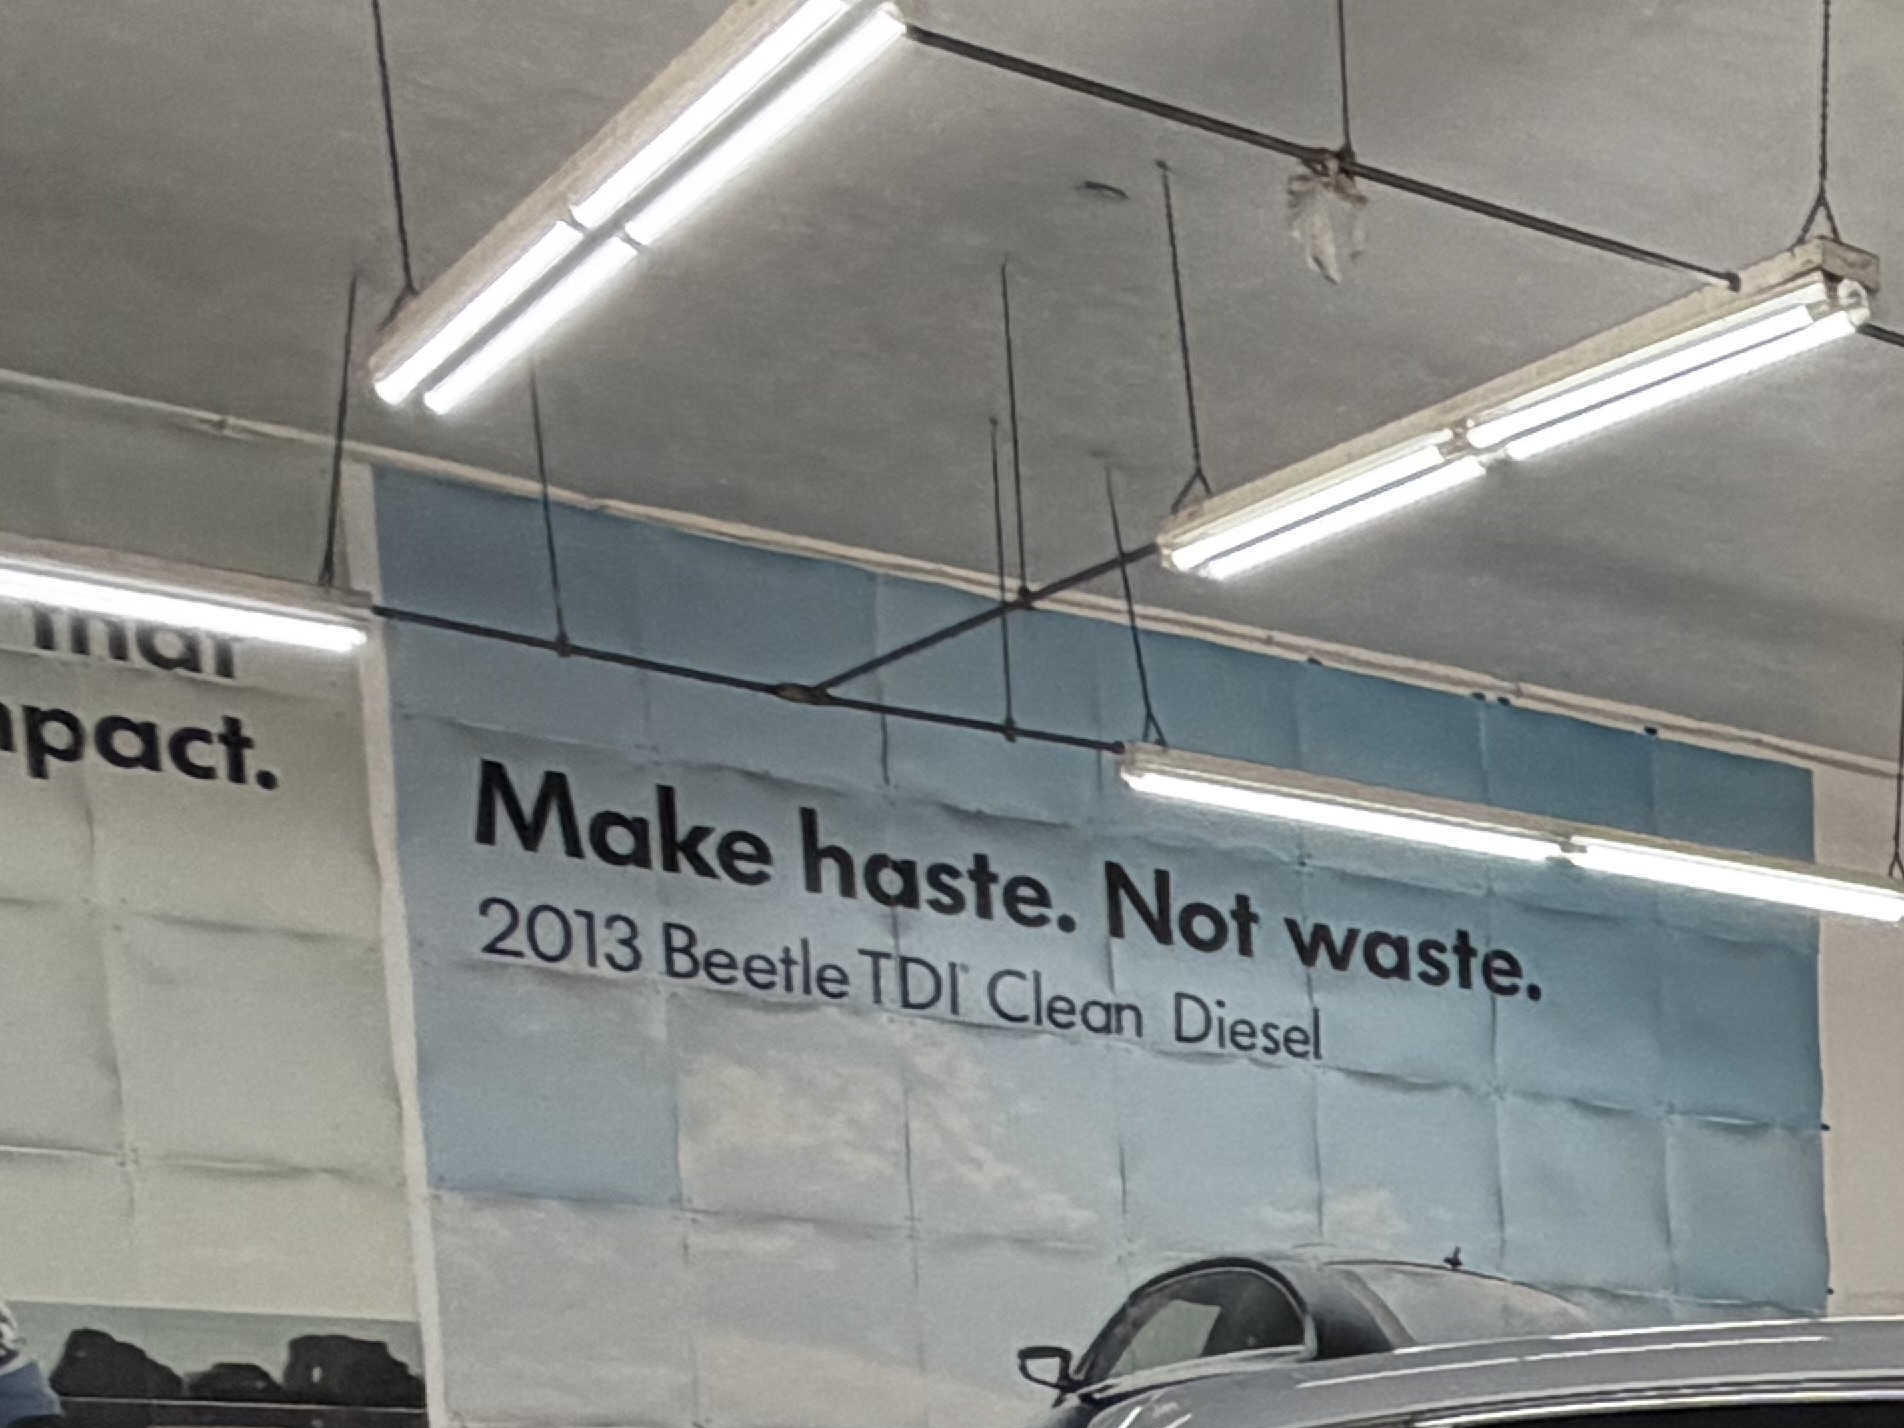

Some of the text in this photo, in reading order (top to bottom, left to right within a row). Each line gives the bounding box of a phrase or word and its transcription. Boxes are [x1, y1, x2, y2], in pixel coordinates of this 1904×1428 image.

[0, 703, 279, 791] pact.
[475, 758, 1543, 1002] Make haste. Not waste.
[478, 895, 643, 973] 2013
[661, 921, 852, 1000] Beetle
[986, 968, 1144, 1039] Clean
[1173, 991, 1323, 1061] Diesel
